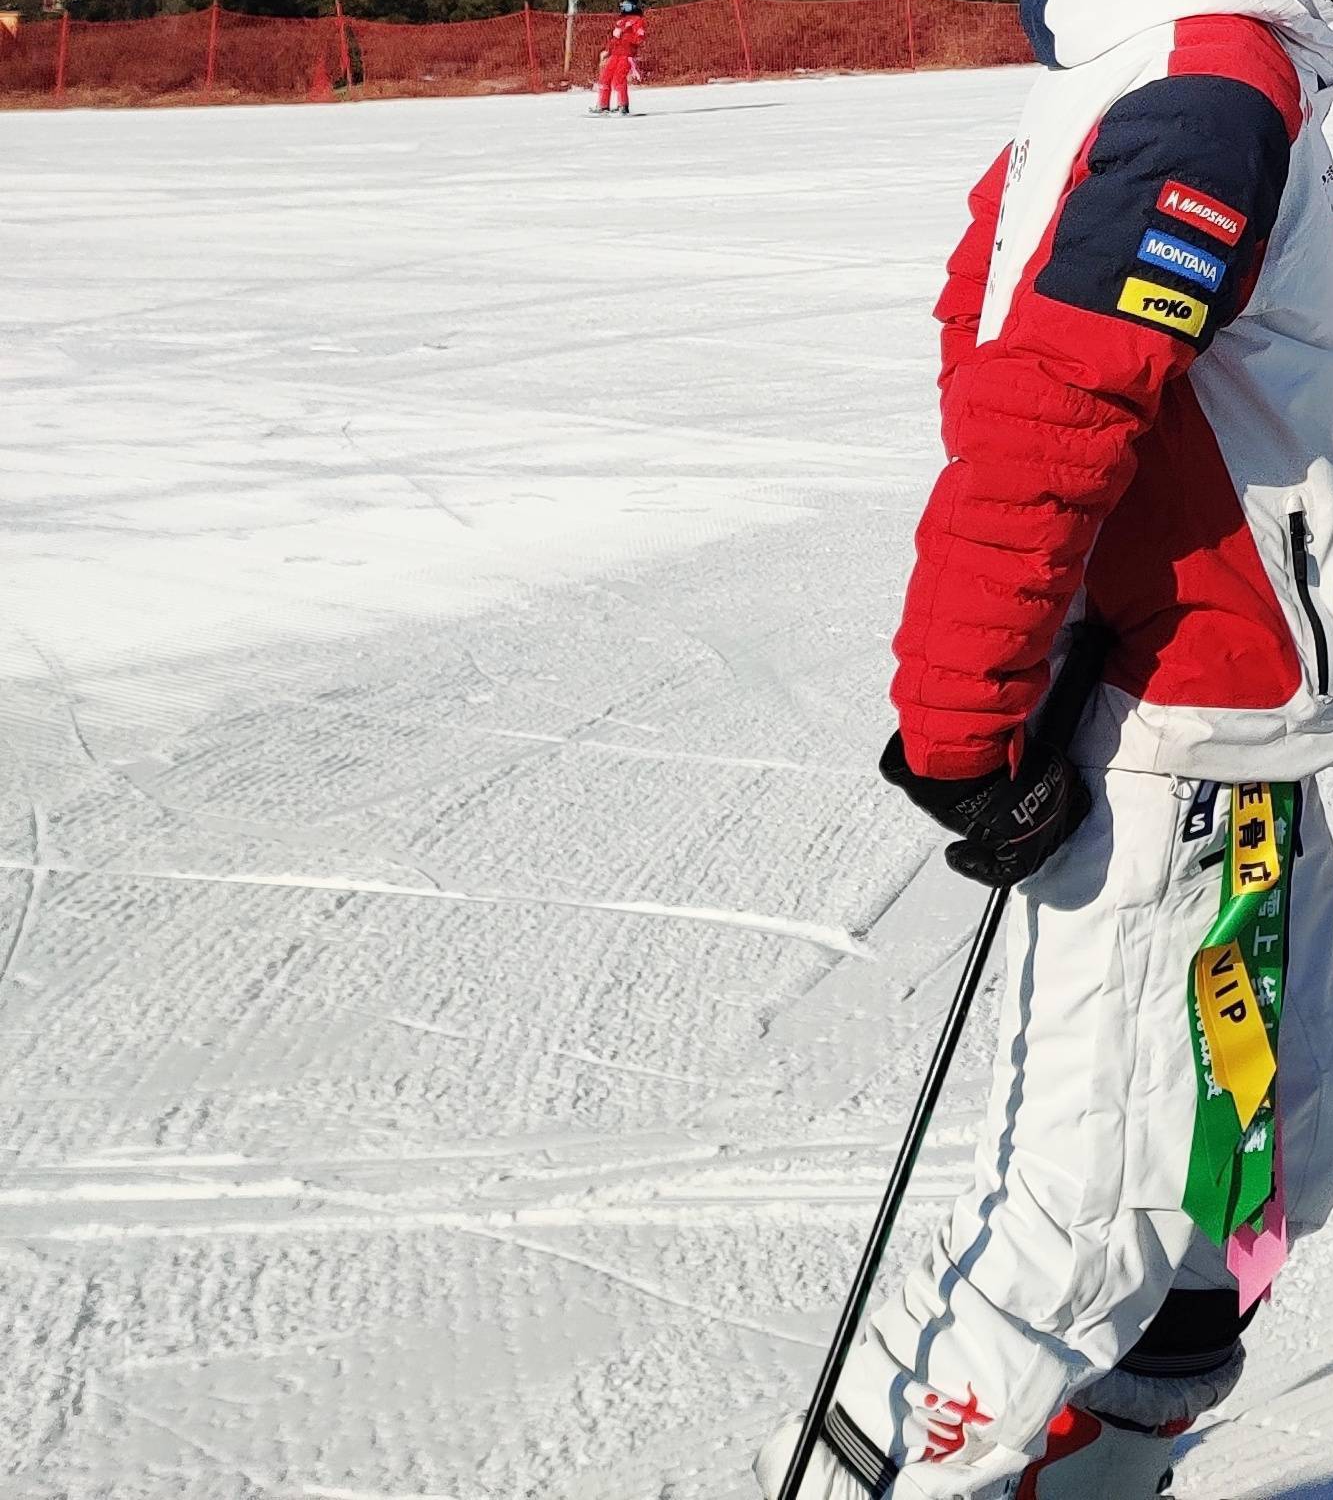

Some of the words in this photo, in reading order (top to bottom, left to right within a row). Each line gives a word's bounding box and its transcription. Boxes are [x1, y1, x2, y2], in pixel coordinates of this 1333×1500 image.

[1178, 197, 1239, 234] MADSHUS
[1146, 238, 1219, 282] MONTANA
[1143, 297, 1193, 320] TOKO
[1010, 756, 1064, 827] eusch
[1211, 948, 1247, 1023] VIP
